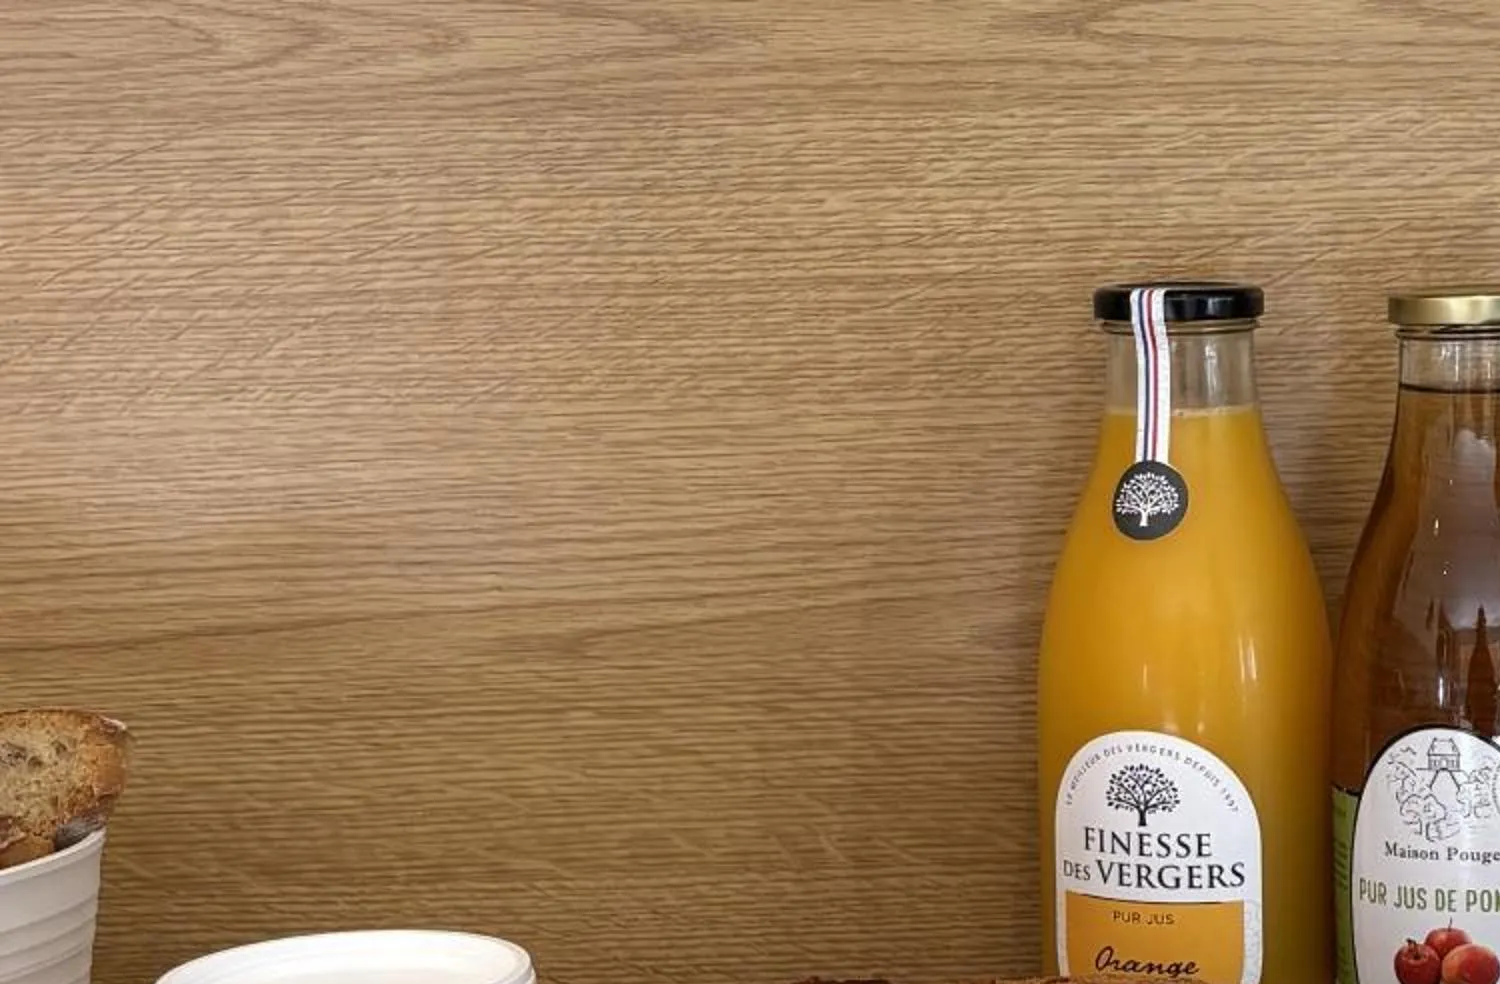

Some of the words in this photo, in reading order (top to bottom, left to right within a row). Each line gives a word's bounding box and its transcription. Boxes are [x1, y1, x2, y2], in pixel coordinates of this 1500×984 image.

[1126, 743, 1180, 761] VERGERS
[1084, 826, 1212, 858] FINESSE
[1385, 841, 1439, 860] Maison
[1063, 860, 1091, 881] DES
[1095, 860, 1246, 890] VERGERS
[1359, 878, 1388, 904] PUR
[1393, 885, 1427, 911] JUS
[1435, 888, 1456, 912] DE
[1113, 910, 1140, 923] PUR
[1146, 912, 1175, 925] JUS
[1095, 946, 1200, 977] Orange
